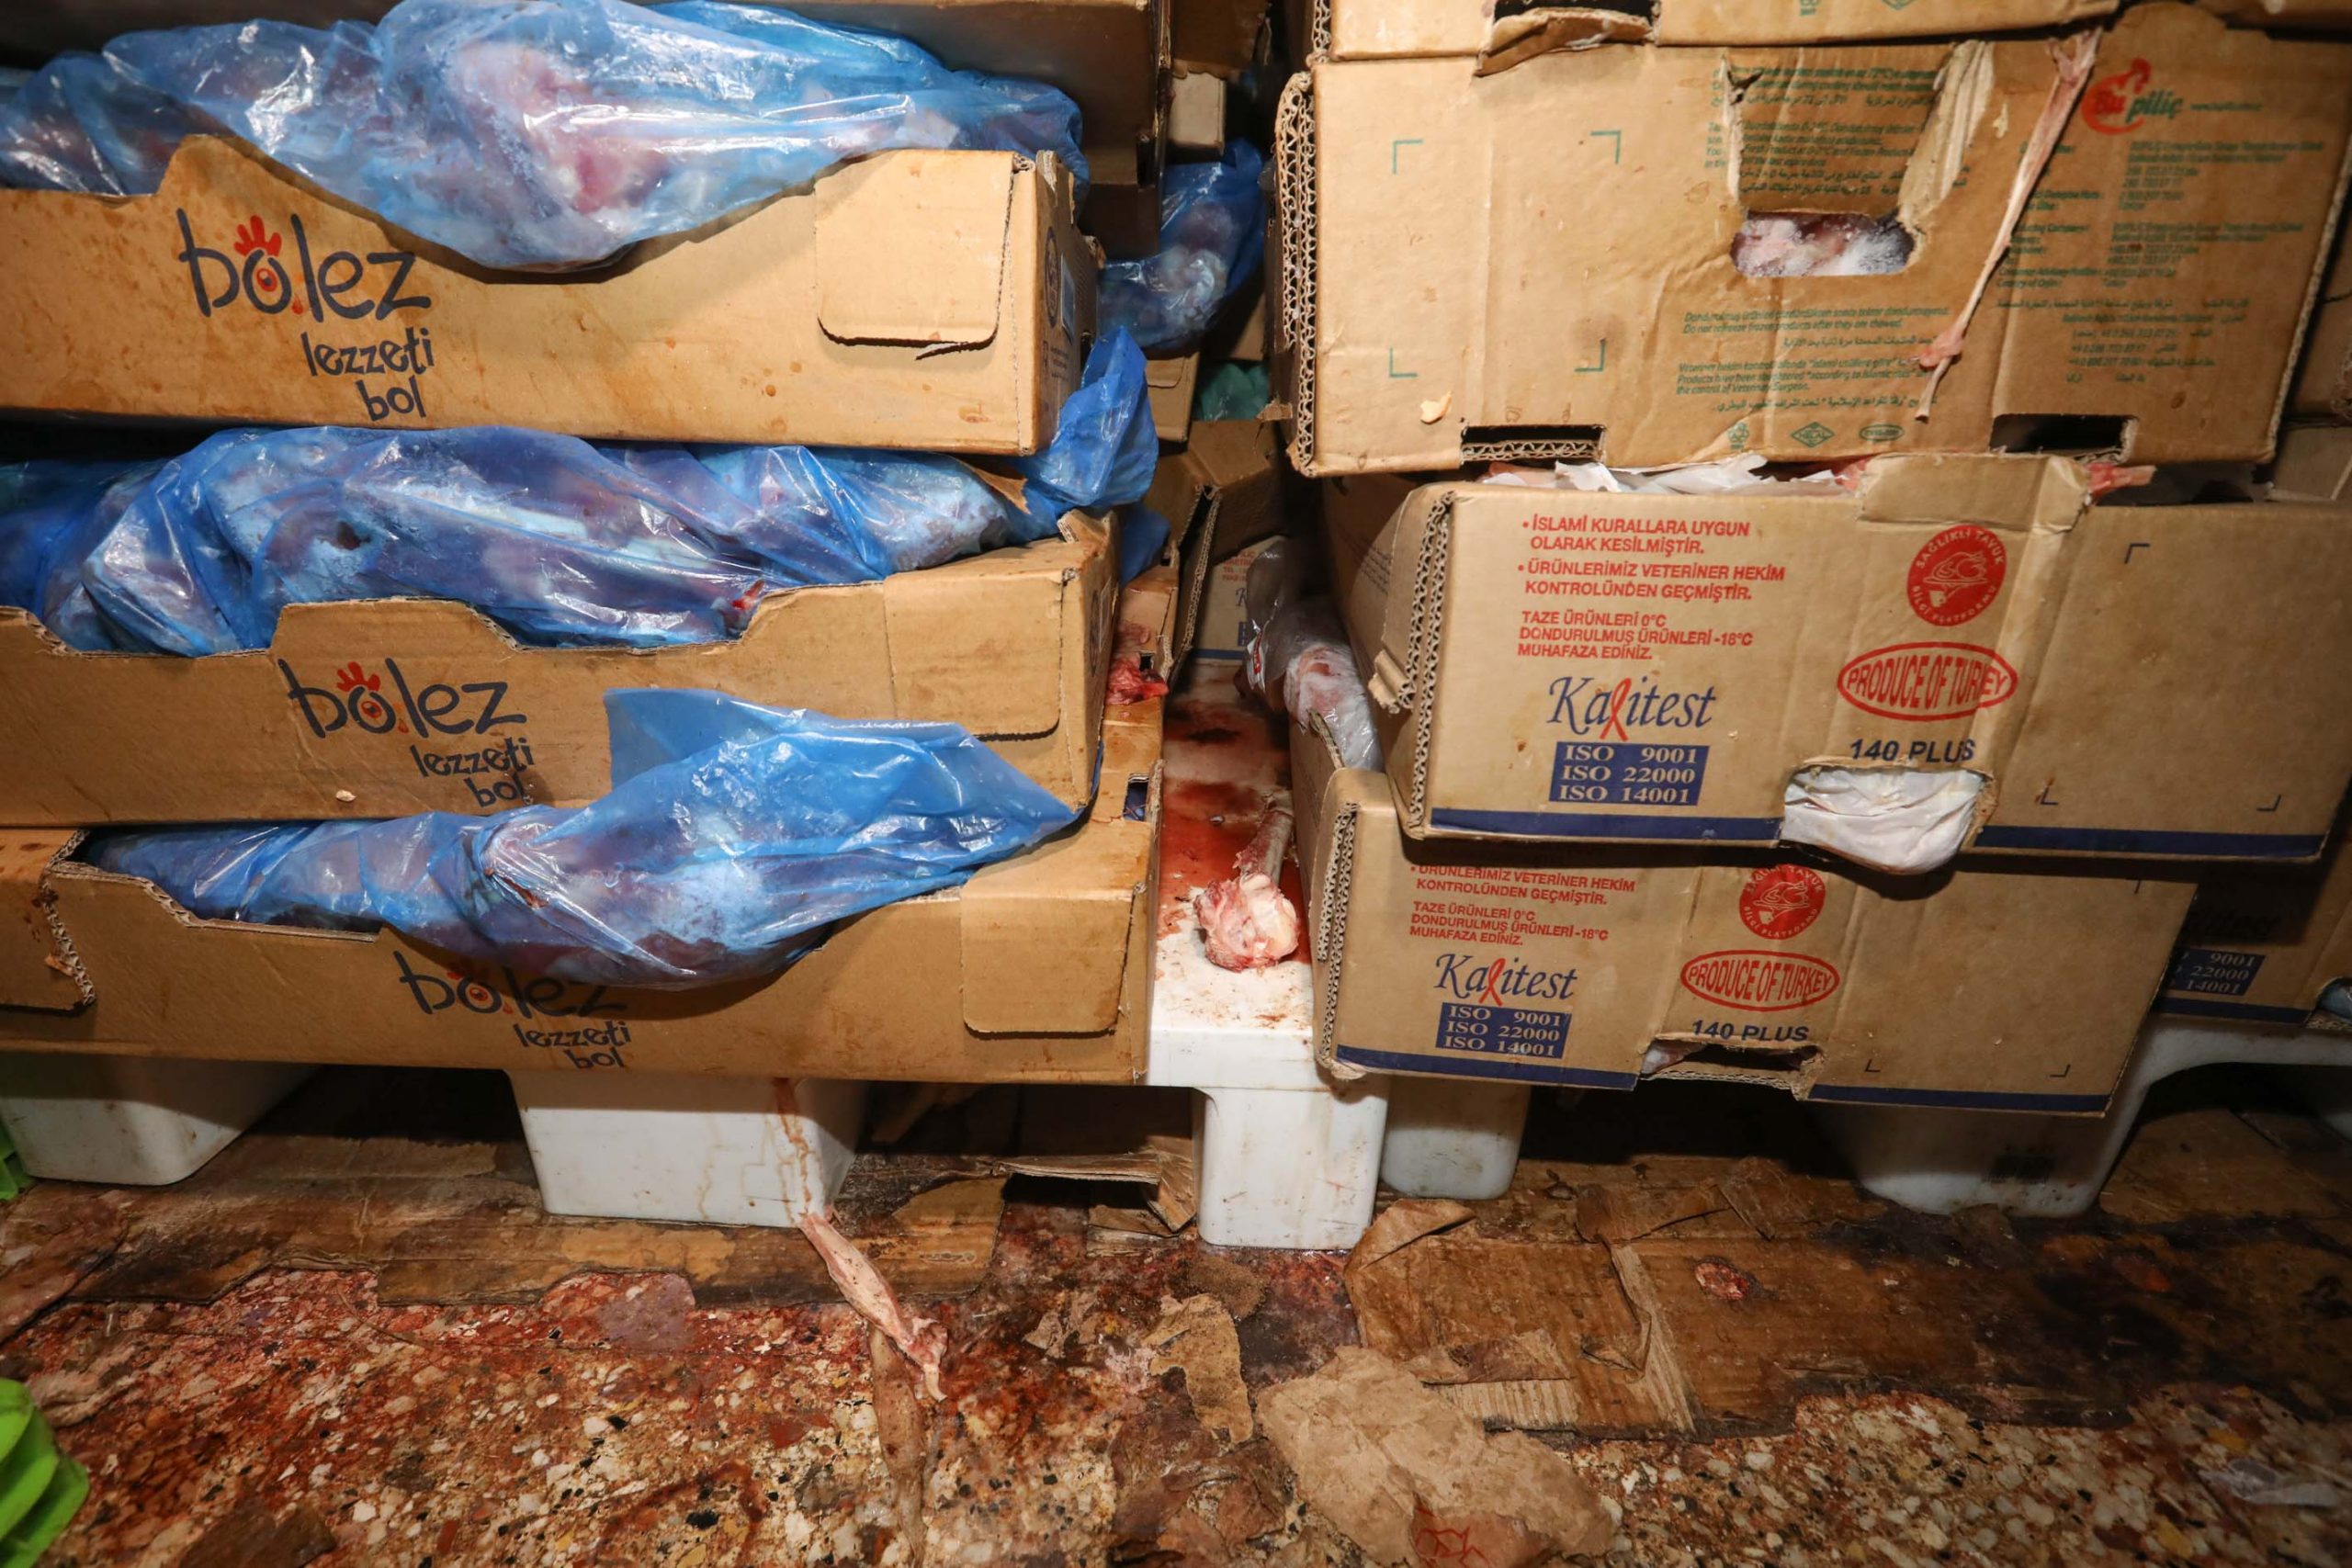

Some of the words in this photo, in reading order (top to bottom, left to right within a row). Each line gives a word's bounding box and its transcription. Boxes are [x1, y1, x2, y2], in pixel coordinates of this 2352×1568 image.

[300, 327, 435, 377] lezzeti
[356, 375, 426, 422] bol
[1532, 513, 1588, 532] İSLAMİ
[1591, 518, 1688, 535] KURALLARA
[1691, 521, 1751, 537] UYGUN
[1531, 536, 1597, 551] OLARAK
[1600, 535, 1705, 558] KESİLMİŞTİR.
[1528, 558, 1638, 578] ÜRÜNLERİMİZ
[1642, 560, 1729, 581] VETERİNER
[1733, 563, 1786, 581] HEKİM
[1525, 580, 1658, 599] KONTROLÜNDEN
[1661, 582, 1753, 604] GEÇMİŞTİR.
[1521, 611, 1560, 625] TAZE
[1564, 609, 1639, 627] ÜRÜNLERİ
[1519, 626, 1634, 646] DONDURULMUŞ
[1637, 628, 1713, 646] ÜRÜNLERİ
[1517, 643, 1599, 659] MUHAFAZA
[1601, 643, 1654, 660] EDİNİZ.
[1846, 654, 1930, 710] PRODUCE
[1925, 654, 1954, 710] OF
[1546, 676, 1717, 742] Kalitest
[409, 737, 536, 777] lezzeti
[1564, 744, 1615, 761] ISO
[1640, 747, 1698, 764] 9001
[1850, 739, 1900, 761] 140
[1908, 739, 1977, 763] PLUS
[1561, 765, 1611, 782] ISO
[1622, 766, 1696, 784] 22000
[463, 773, 526, 809] bol
[1558, 785, 1608, 802] ISO
[1622, 786, 1690, 804] 14001
[1417, 878, 1528, 899] KONTROLÜNDEN
[1531, 887, 1609, 907] GEÇMİŞTİR.
[1514, 871, 1589, 889] VETERİNER
[1591, 875, 1636, 893] HEKİM
[1413, 901, 1445, 914] TAZE
[1448, 902, 1511, 919] ÜRÜNLERİ
[1409, 925, 1477, 942] MUHAFAZA
[1411, 913, 1509, 934] DONDURULMUŞ
[1510, 921, 1574, 938] ÜRÜNLERİ
[2210, 953, 2256, 967] 9001
[1433, 953, 1578, 1007] Kalitest
[1688, 960, 1761, 1001] PRODUCE
[1755, 961, 1782, 1003] OF
[1777, 963, 1832, 1001] TURKEY
[2190, 964, 2251, 981] 22000
[2187, 978, 2242, 995] 14001
[1448, 1005, 1491, 1021] ISO
[1513, 1010, 1562, 1027] 9001
[513, 1021, 632, 1048] lezzeti
[1445, 1021, 1488, 1036] ISO
[1498, 1025, 1561, 1042] 22000
[1692, 1020, 1735, 1040] 140
[1741, 1024, 1810, 1043] PLUS
[1442, 1035, 1486, 1051] ISO
[1493, 1040, 1555, 1056] 14001
[563, 1047, 627, 1070] bol
